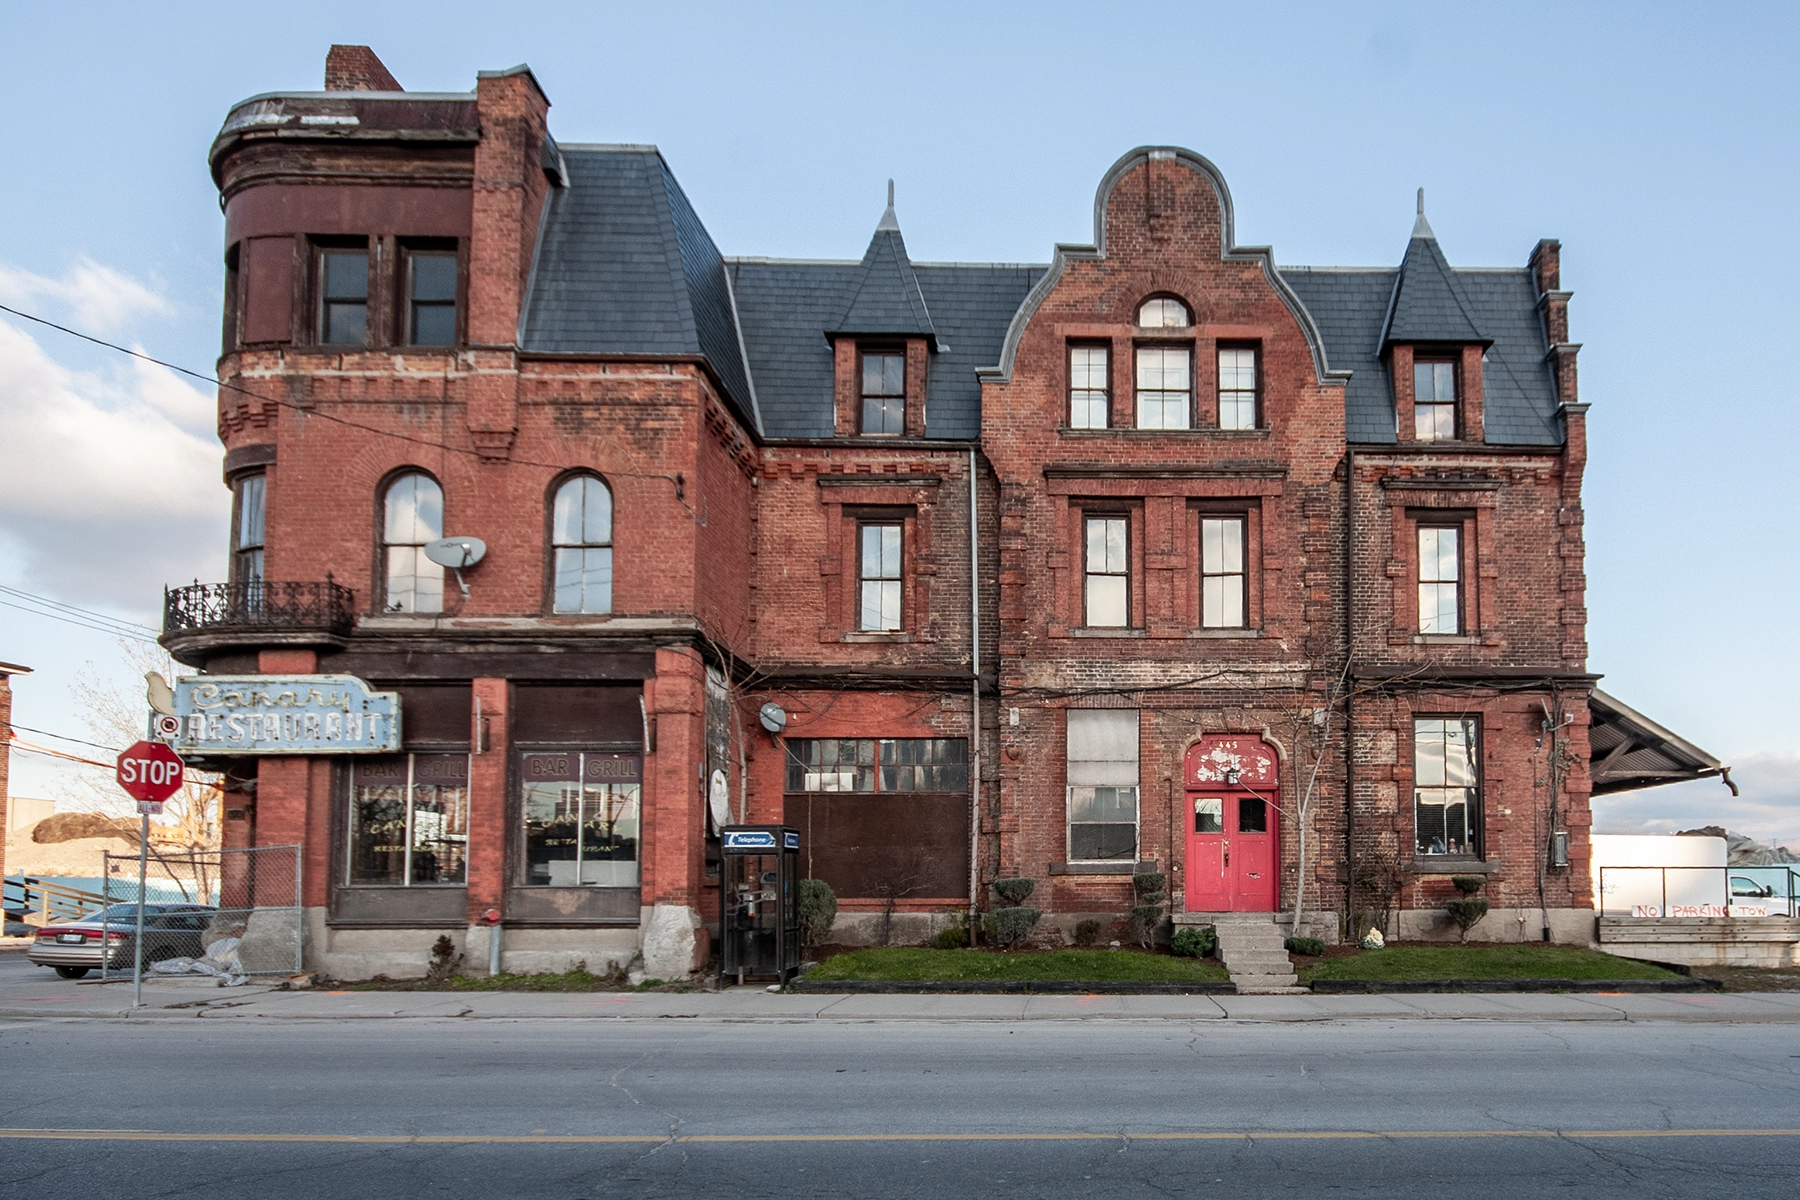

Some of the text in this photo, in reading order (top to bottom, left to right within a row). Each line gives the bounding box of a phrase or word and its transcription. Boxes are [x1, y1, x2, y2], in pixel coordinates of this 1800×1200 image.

[190, 683, 350, 713] Canary
[187, 712, 382, 742] RESTAURANT
[1218, 741, 1238, 749] 445
[121, 757, 181, 786] STOP
[362, 760, 466, 778] BAR GRILL
[531, 758, 637, 777] BAR GRILL
[1637, 905, 1767, 917] NO PARKING TOW
